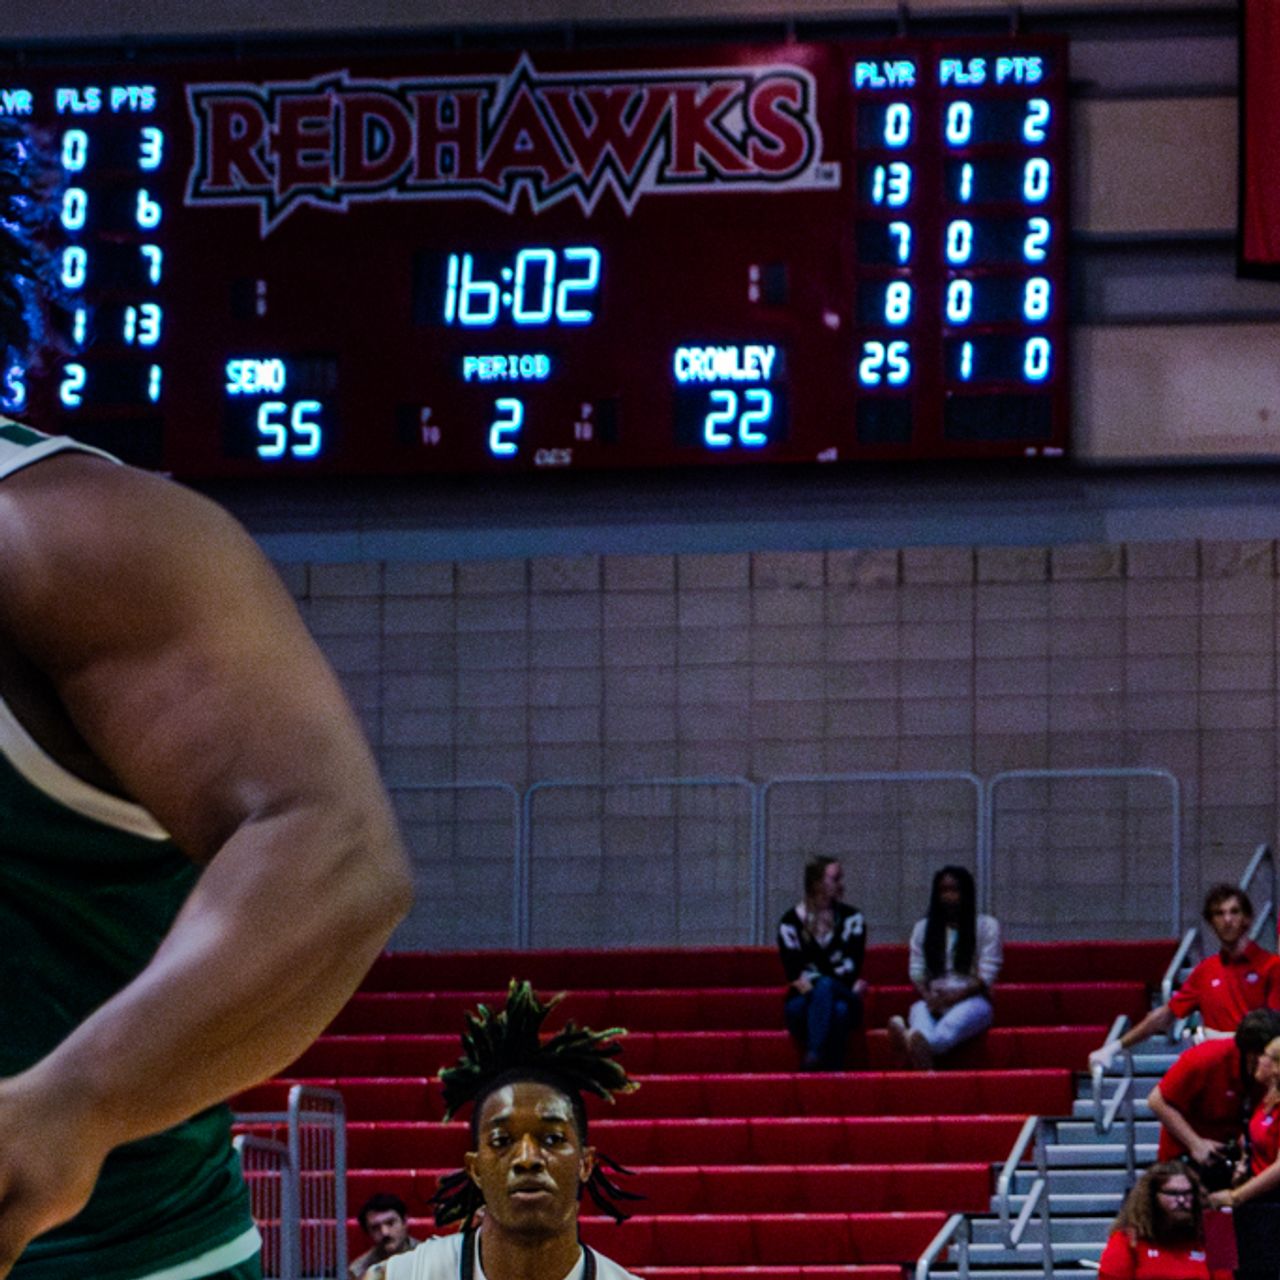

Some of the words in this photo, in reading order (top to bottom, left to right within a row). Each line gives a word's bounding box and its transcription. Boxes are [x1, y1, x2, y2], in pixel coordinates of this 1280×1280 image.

[940, 58, 986, 87] FLS
[996, 56, 1043, 85] PTS
[56, 86, 101, 114] FLS
[109, 84, 156, 113] PTS
[884, 102, 911, 148] 0
[946, 100, 974, 146] 0
[1023, 97, 1051, 144] 2
[61, 128, 89, 172] 0
[137, 126, 163, 173] 3
[190, 60, 822, 217] REDHAWKS
[871, 161, 912, 208] 13
[958, 161, 974, 205] 1
[1023, 156, 1051, 203] 0
[60, 186, 88, 231] 0
[136, 188, 163, 231] 6
[887, 219, 912, 264] 7
[946, 218, 974, 265] 0
[1023, 215, 1051, 262] 2
[60, 245, 88, 289] 0
[139, 243, 163, 287] 7
[443, 247, 602, 326] 16:02
[73, 307, 87, 346] 1
[123, 302, 163, 346] 13
[884, 279, 912, 327] 8
[946, 278, 974, 325] 0
[1023, 275, 1051, 322] 8
[58, 361, 87, 408] 2
[146, 362, 162, 403] 1
[225, 359, 287, 395] SEMO
[462, 354, 551, 382] PERIOD
[674, 345, 778, 383] CROWLEY
[858, 339, 912, 387] 25
[958, 339, 974, 382] 1
[1023, 335, 1051, 383] 0
[257, 401, 323, 458] 55
[488, 397, 524, 456] 2
[703, 389, 773, 447] 22
